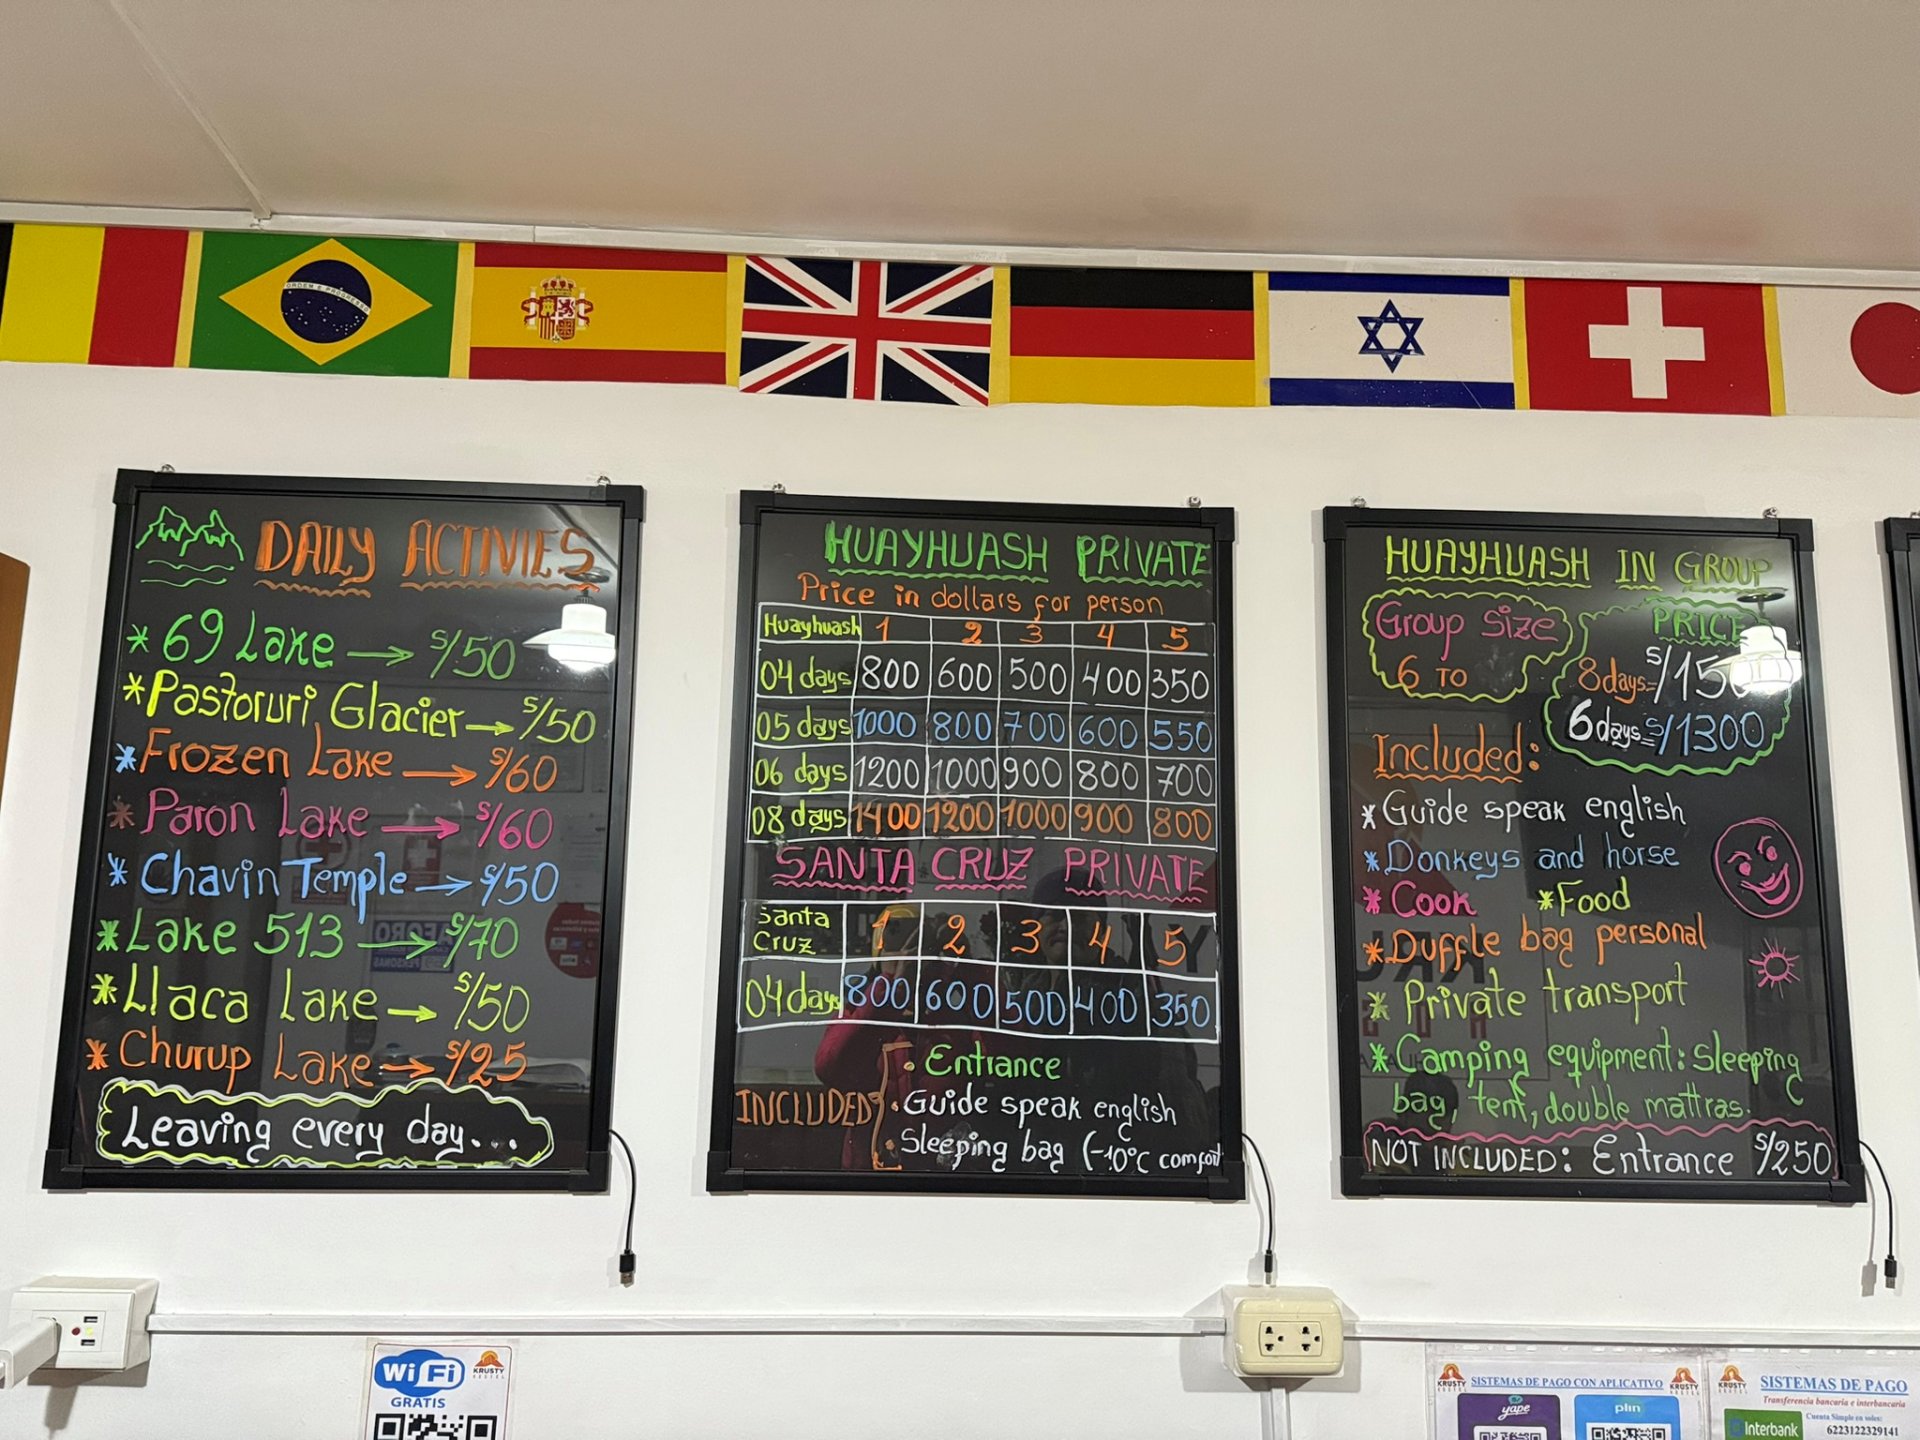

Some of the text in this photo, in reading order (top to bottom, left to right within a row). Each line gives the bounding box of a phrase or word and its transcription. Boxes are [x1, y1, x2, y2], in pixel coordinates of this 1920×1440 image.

[286, 282, 314, 290] ORDEM
[255, 518, 596, 586] DAILY ACTIVIES
[824, 520, 1212, 582] HUAYHUASH PRIVATE
[1386, 536, 1774, 587] HUAYHUASH IN GROUP
[797, 571, 1164, 622] Price in dollars for person
[162, 609, 226, 665] 69
[236, 610, 335, 669] Lake
[763, 613, 1190, 652] Huayhuash 1 2 3 4 5
[1375, 601, 1466, 662] Group
[1653, 606, 1748, 641] PRICE
[760, 655, 1210, 701] 04 days 800 600 500 400 350
[1397, 654, 1420, 690] 6
[147, 669, 318, 728] Pastoruri
[332, 681, 466, 739] Glacier
[140, 727, 290, 779] Frozen
[308, 722, 393, 780] Lake
[757, 703, 1213, 755] 05 days 1000 800 700 600 550
[1373, 722, 1540, 774] Included:
[755, 752, 1213, 798] 06 days 1200 1000 900 800 700
[141, 787, 256, 837] Paron
[279, 787, 370, 839] Lake
[751, 799, 1213, 842] 08 days 1400 1200 1000 900 800
[1382, 784, 1687, 838] Guide speak english
[771, 846, 1210, 893] SANTA CRUZ PRIVATE
[1385, 832, 1680, 880] Donkeys and horse
[141, 852, 279, 899] Chavin
[282, 852, 407, 924] Temple
[1391, 880, 1478, 918] Cook
[1556, 877, 1631, 914] Food
[126, 907, 237, 953] Lake
[254, 912, 344, 960] 513
[757, 906, 831, 929] Santa
[871, 909, 1188, 967] 1 2 3 4 5
[753, 930, 817, 955] Cruz
[1385, 912, 1708, 973] Duffle bag personal
[122, 964, 250, 1024] Llaca
[280, 967, 379, 1024] Lake
[844, 974, 910, 1010] 800
[925, 978, 993, 1020] 600
[1002, 991, 1067, 1027] 500
[1075, 987, 1139, 1026] 400
[1151, 994, 1211, 1028] 350
[1403, 967, 1526, 1024] Private
[1542, 961, 1689, 1024] transport
[119, 1028, 251, 1095] Churup
[274, 1033, 375, 1086] Lake
[925, 1043, 1062, 1081] Entrance
[1396, 1033, 1530, 1092] Camping
[736, 1089, 875, 1127] INCLUDED
[903, 1083, 1177, 1142] Guide speak english
[121, 1107, 385, 1164] Leaving every
[900, 1127, 1222, 1174] Sleeping bag comfort
[1371, 1138, 1422, 1174] NOT
[1592, 1131, 1735, 1177] Entrance
[473, 1367, 505, 1375] KRUSTY
[1437, 1380, 1467, 1388] KRUSTY
[1471, 1376, 1664, 1389] SISTEMAS DE PAGO CON APLICATIVO
[1669, 1383, 1699, 1391] KRUSTY
[1718, 1382, 1747, 1390] KRUSTY
[1760, 1375, 1908, 1393] SISTEMAS DE PAGO
[391, 1397, 446, 1409] GRATIS
[1498, 1404, 1531, 1421] yape
[1763, 1395, 1906, 1408] Transferencia bancaria interbancaria
[1744, 1421, 1799, 1437] Interbank
[1826, 1425, 1899, 1437] 6223122329141
